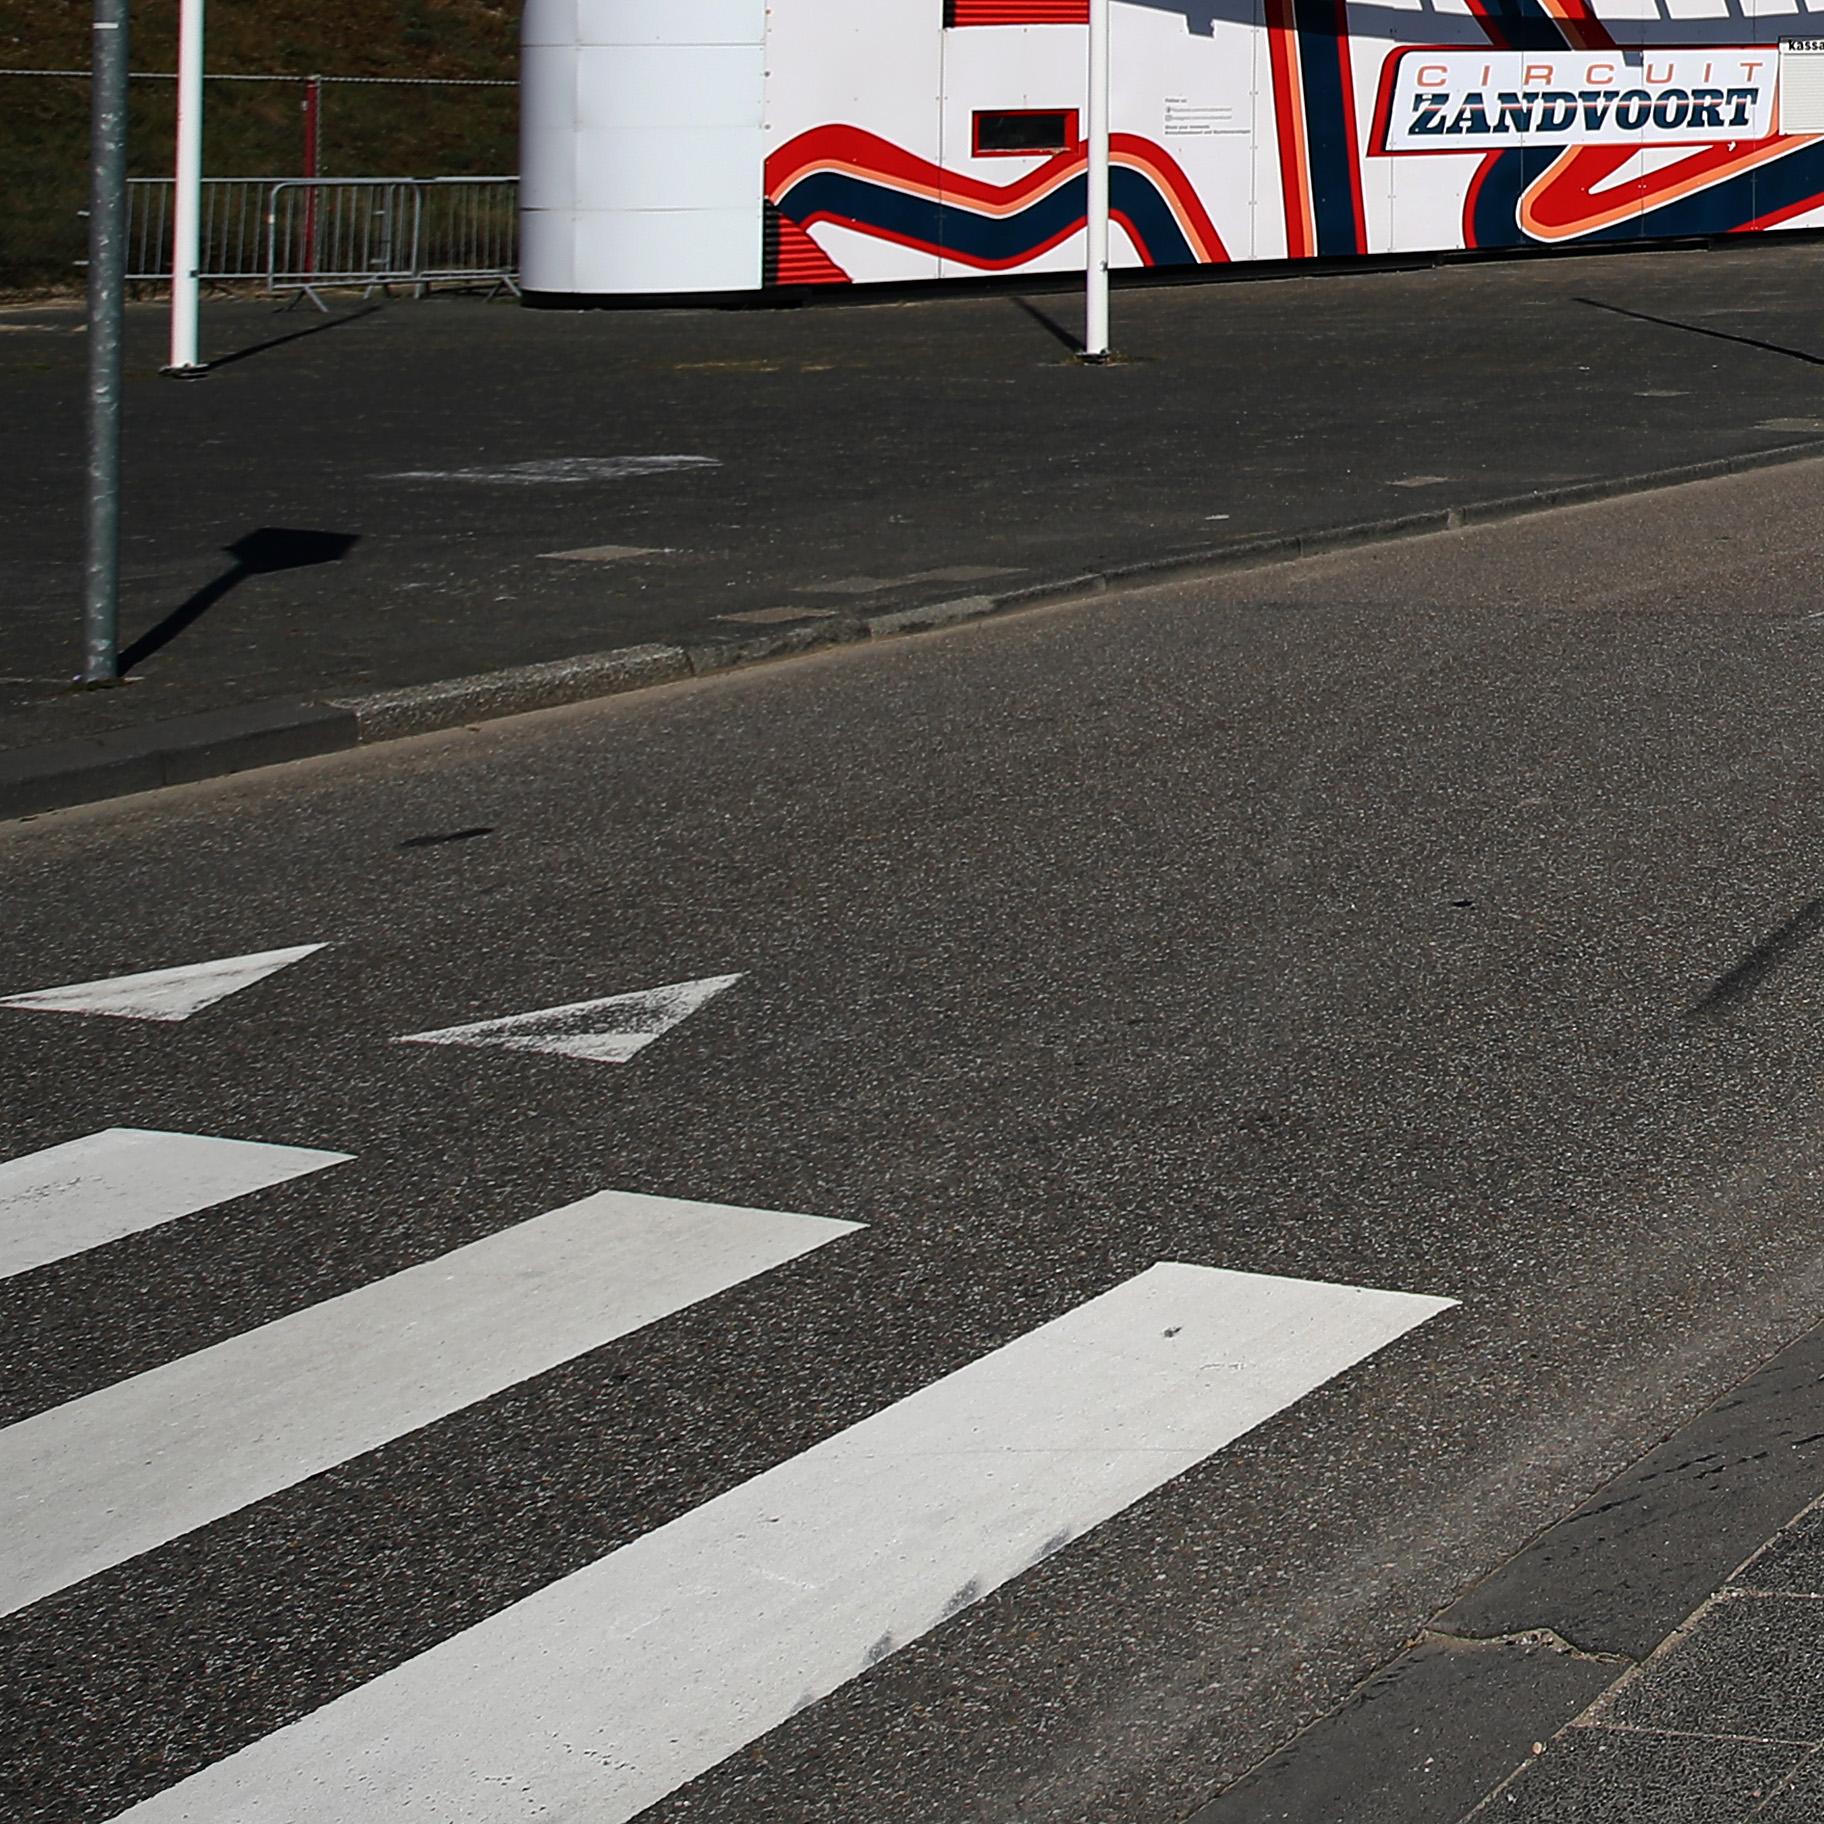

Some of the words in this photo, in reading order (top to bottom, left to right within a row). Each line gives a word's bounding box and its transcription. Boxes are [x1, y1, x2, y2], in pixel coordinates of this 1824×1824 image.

[1789, 39, 1824, 50] kassa
[1417, 62, 1763, 87] CIRCUIT
[1408, 87, 1759, 136] ZANDVOORT
